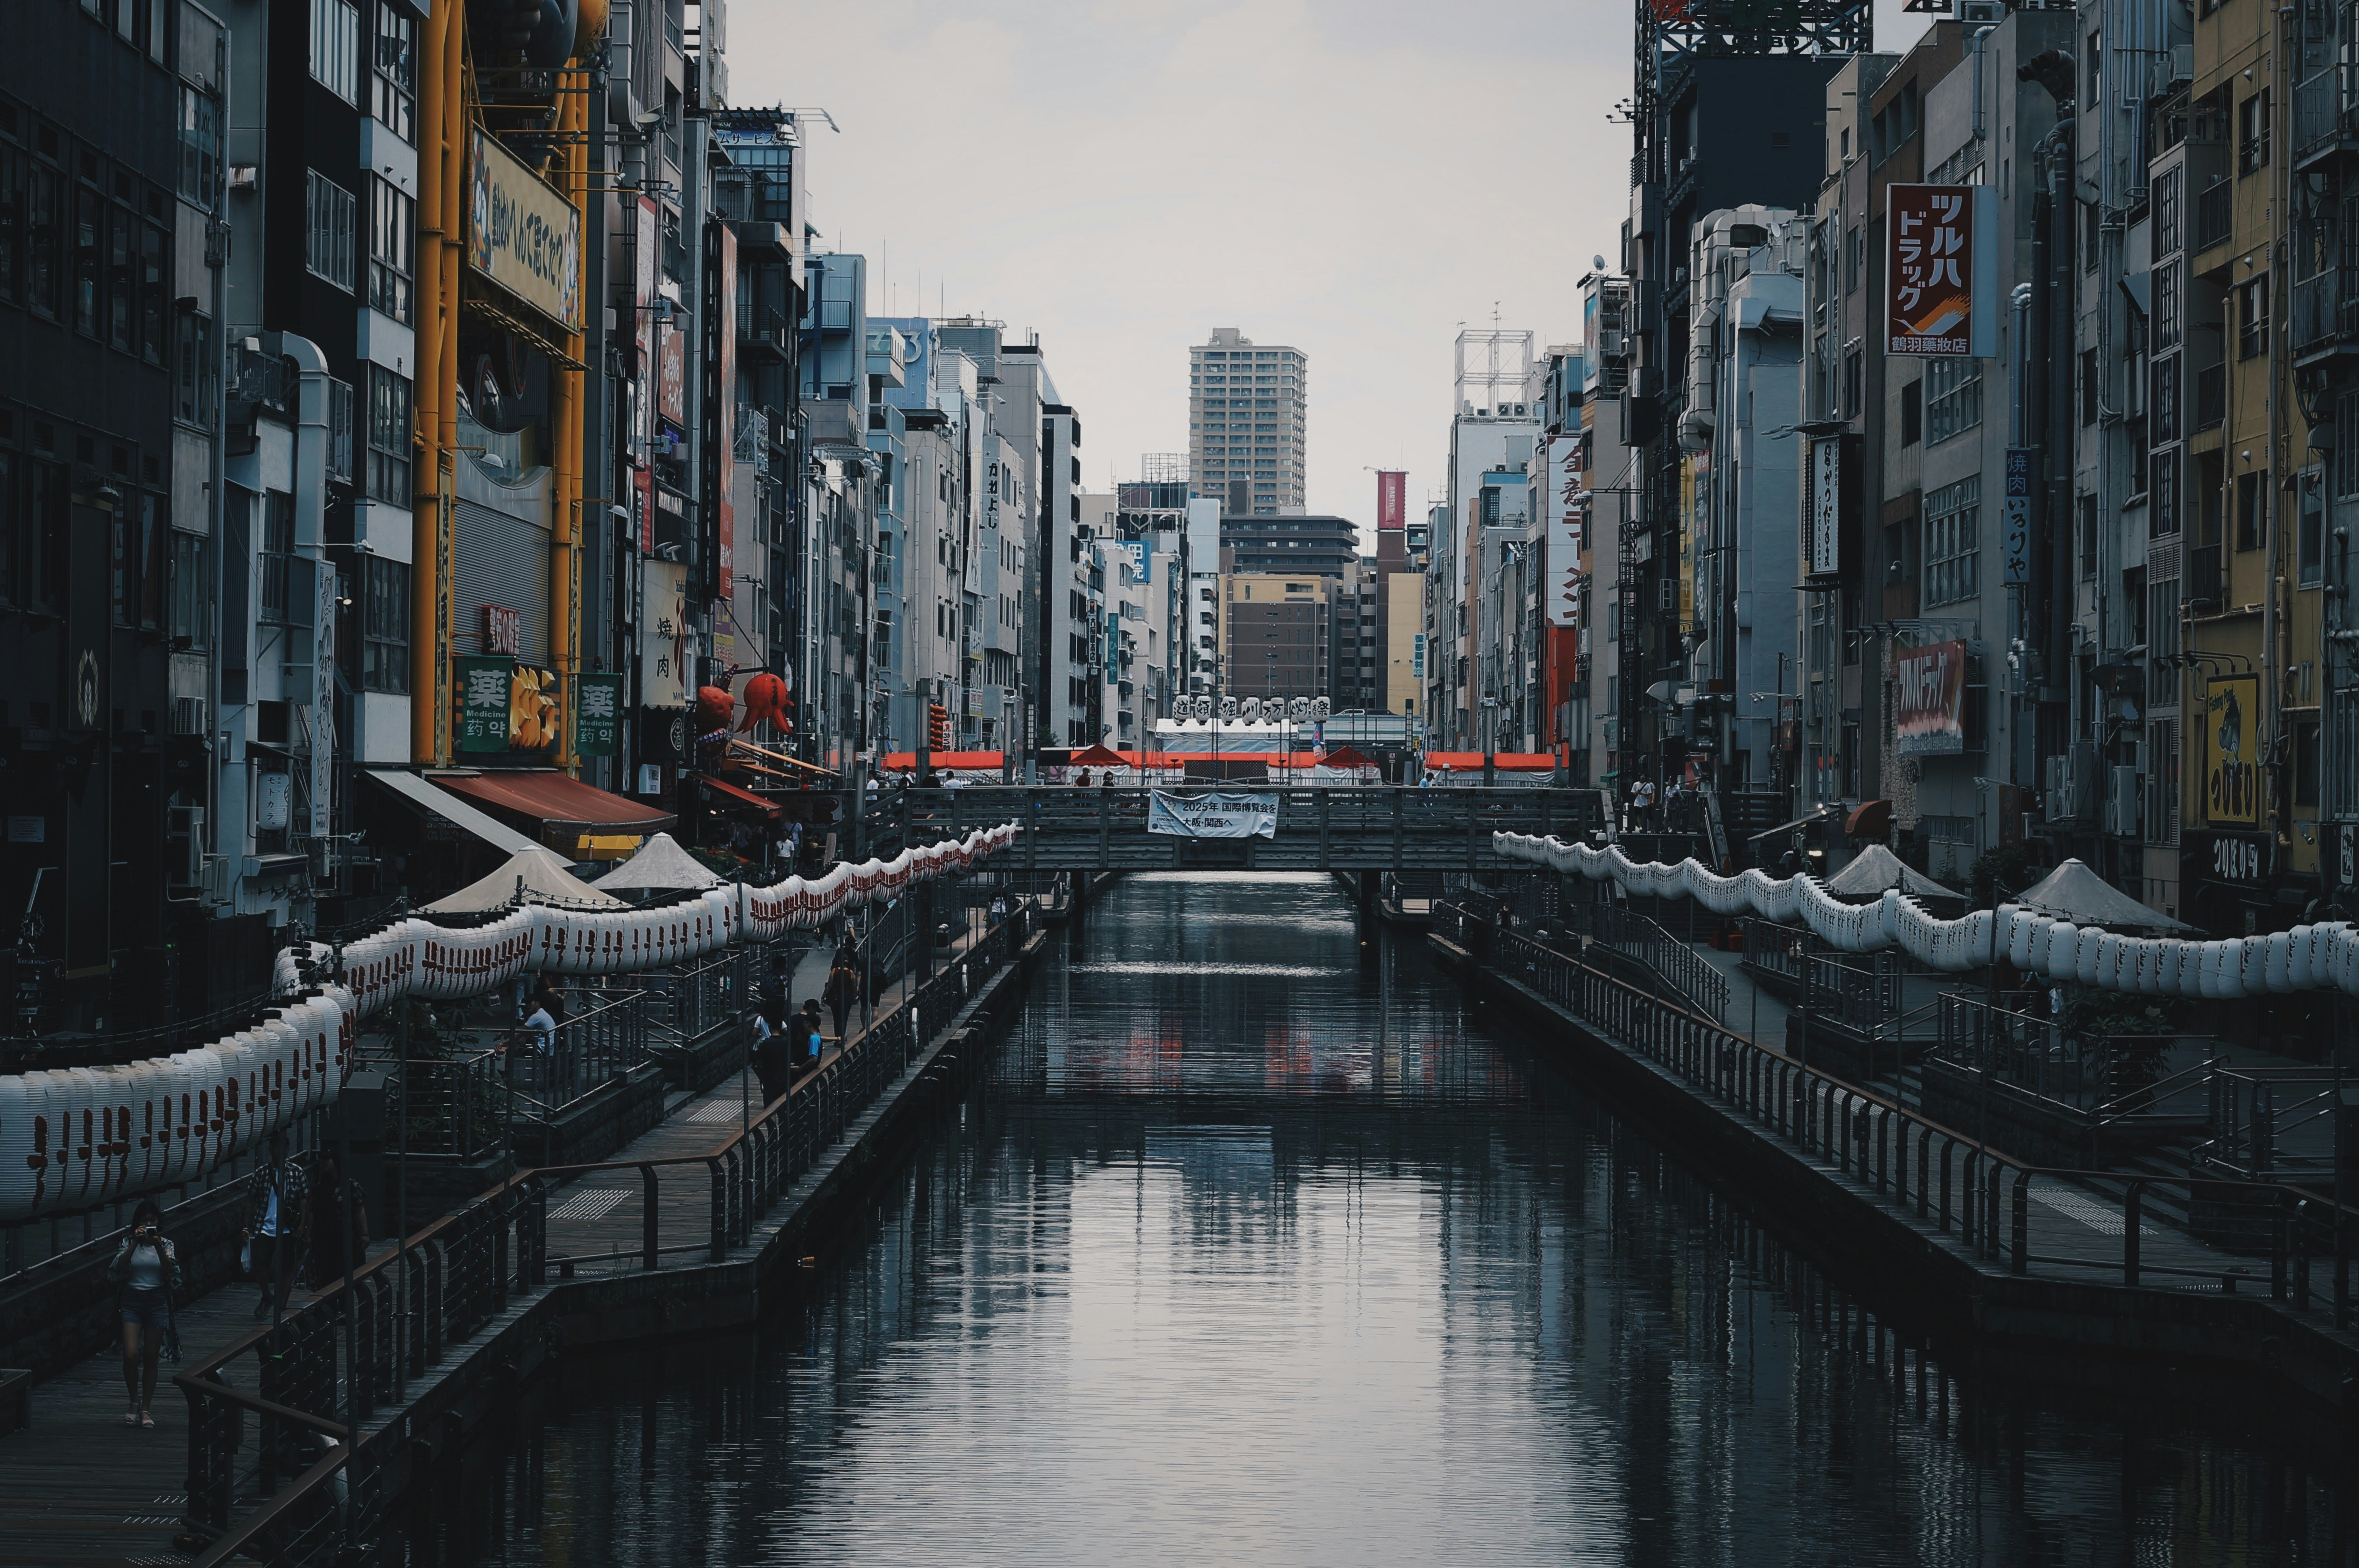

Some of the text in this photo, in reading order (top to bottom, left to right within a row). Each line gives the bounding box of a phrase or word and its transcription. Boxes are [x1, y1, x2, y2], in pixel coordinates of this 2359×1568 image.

[1929, 195, 1963, 288] ツルハ
[1898, 211, 1926, 311] ドラッグ
[1892, 336, 1967, 353] 鶴羽藥妝店
[2008, 454, 2026, 493] 焼肉
[988, 463, 998, 529] かねよし
[2008, 500, 2026, 580] いろりや
[657, 618, 673, 679] 焼肉
[1109, 642, 1118, 676] ひさや
[469, 669, 506, 707] 薬
[1900, 652, 1946, 711] ツルハドラッグ
[581, 685, 614, 717] 薬
[2209, 690, 2223, 713] Fishing
[467, 719, 484, 737] 药
[489, 721, 505, 738] 약
[580, 728, 595, 743] 药
[600, 729, 613, 744] 약
[1182, 802, 1277, 814] 2025年 国際博覧会を
[2211, 761, 2253, 818] つりぼり
[2214, 838, 2246, 879] つりぼり
